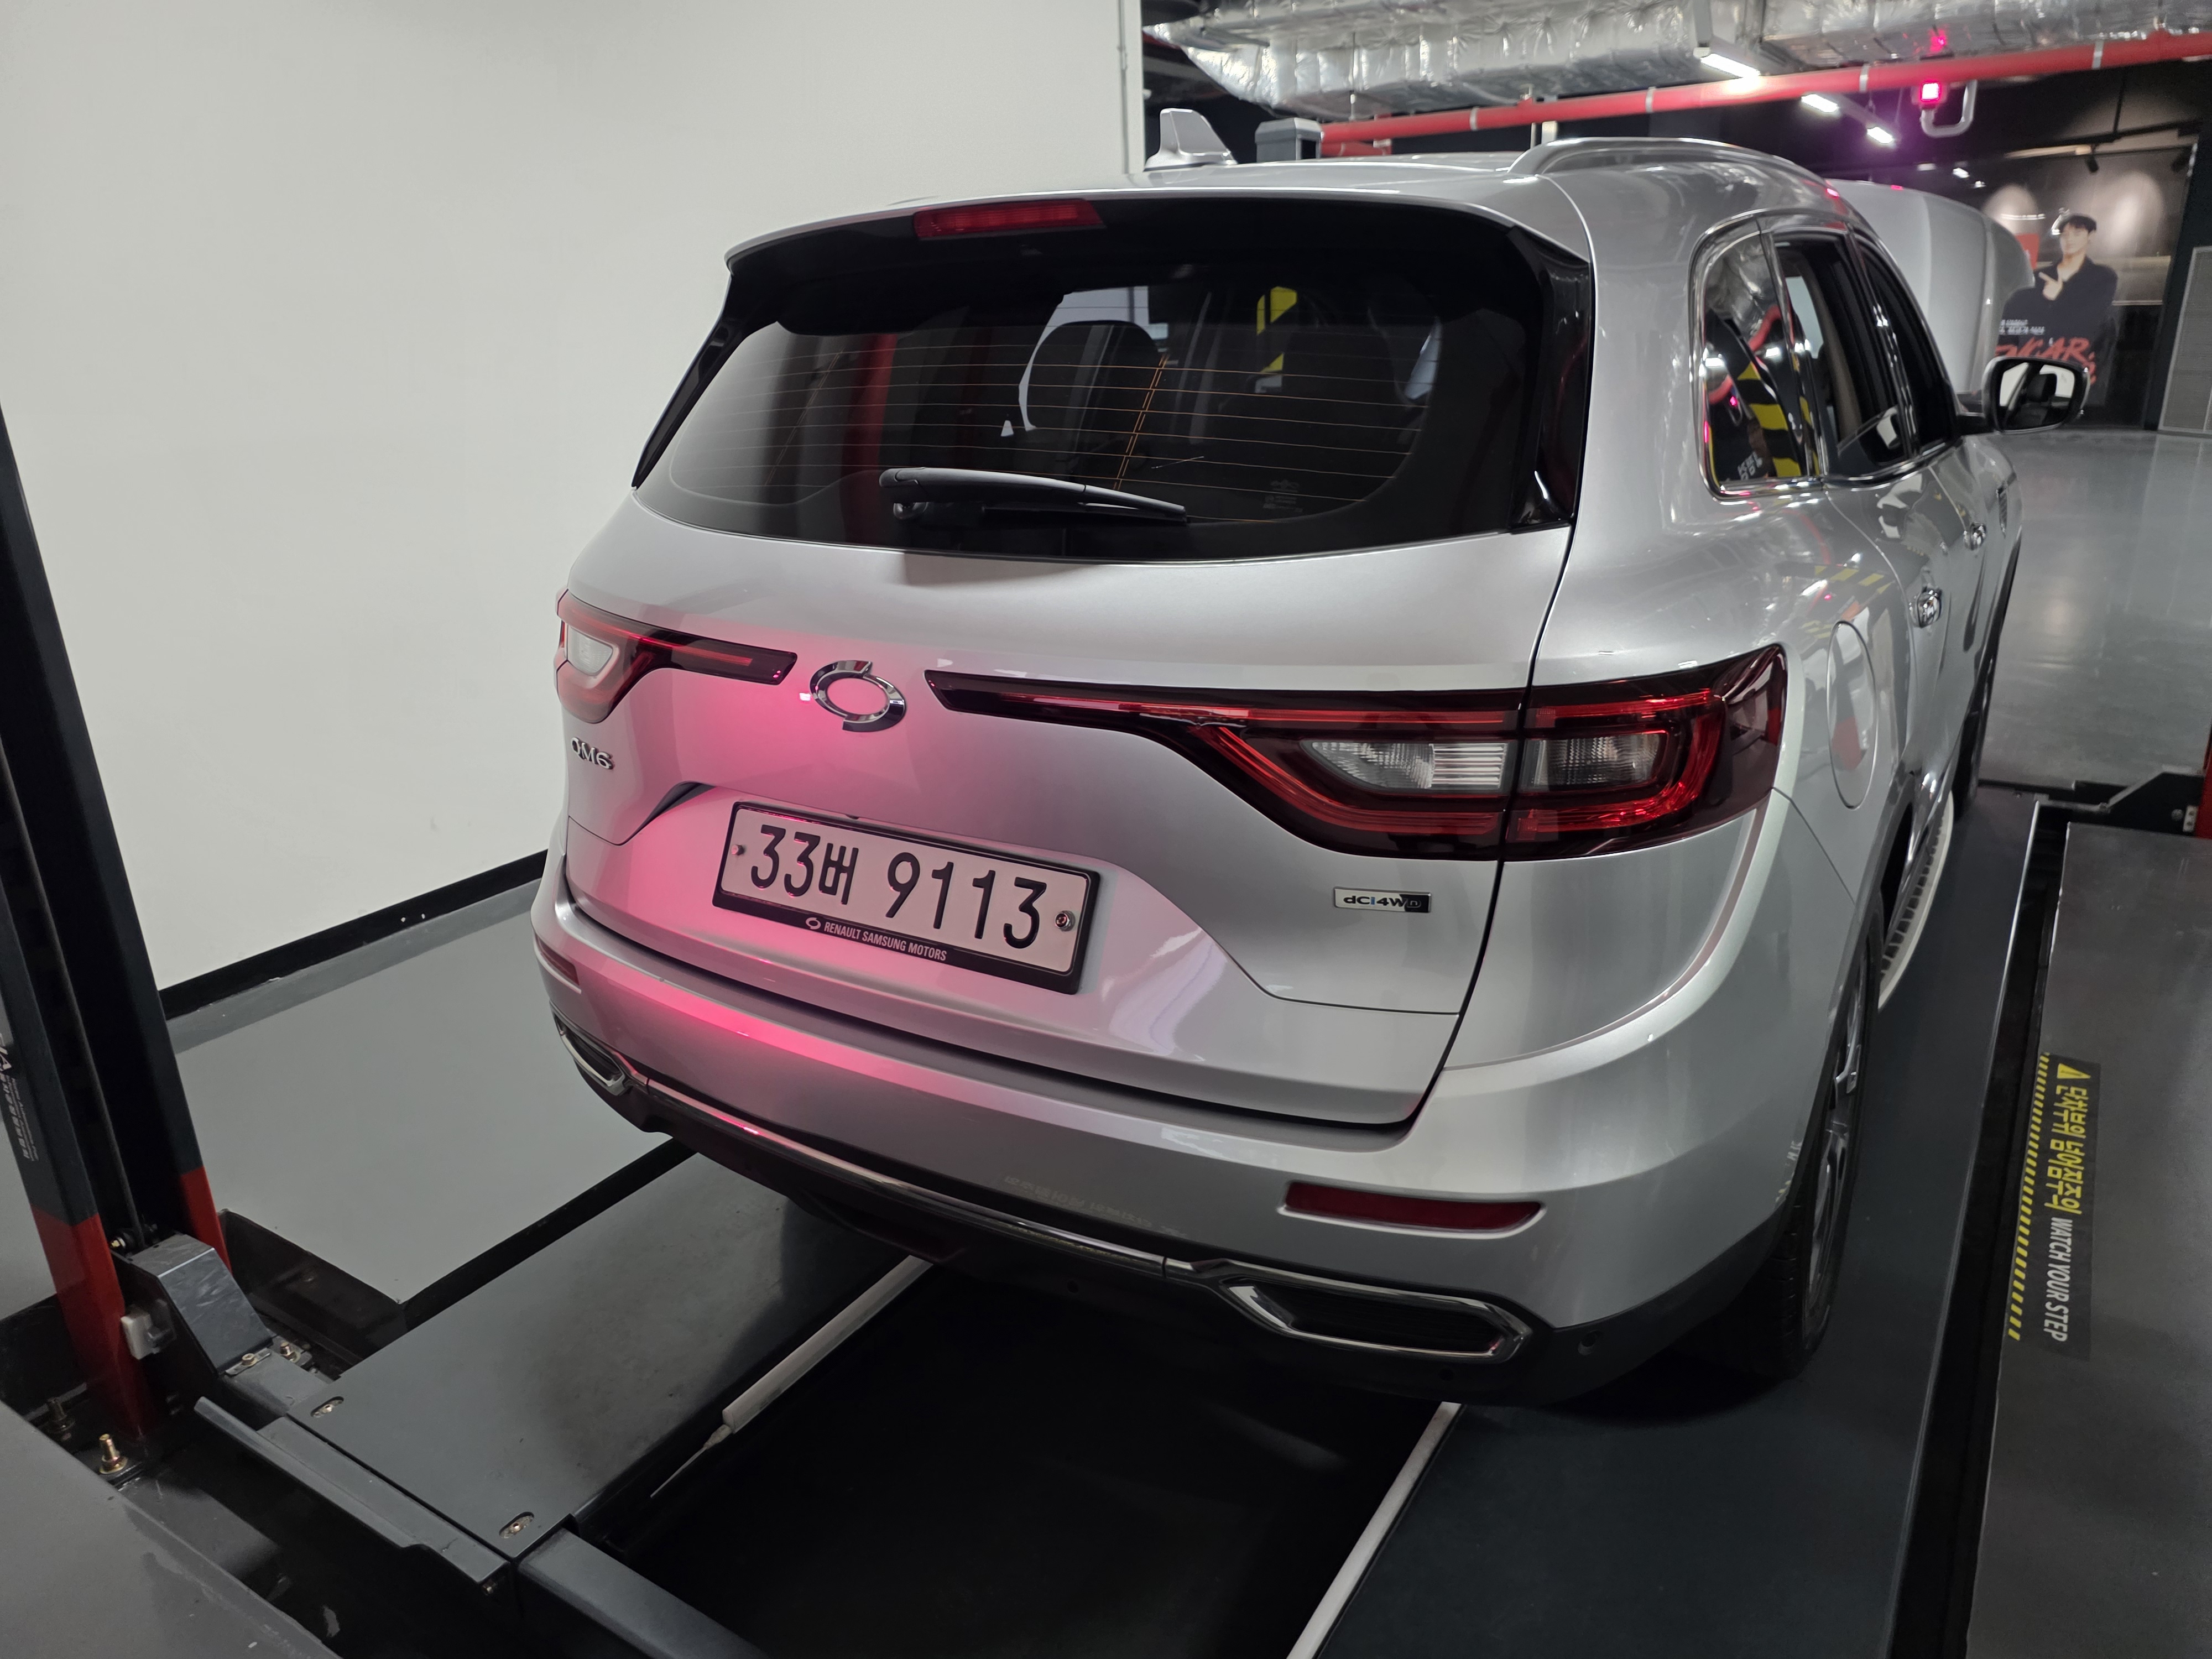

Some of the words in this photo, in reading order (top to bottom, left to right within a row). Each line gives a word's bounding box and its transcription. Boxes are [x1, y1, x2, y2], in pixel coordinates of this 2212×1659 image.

[571, 737, 614, 769] QM6
[750, 823, 859, 905] 33버
[885, 852, 1047, 949] 9113
[823, 921, 861, 940] RENAULT
[862, 931, 906, 951] SAMSUNG
[907, 942, 947, 962] MOTORS
[2051, 1086, 2089, 1139] 단차부위
[2044, 1139, 2084, 1215] 넘어짐주의
[2048, 1216, 2074, 1262] WATCH
[2047, 1262, 2071, 1302] YOUR
[2043, 1301, 2068, 1342] STEP
